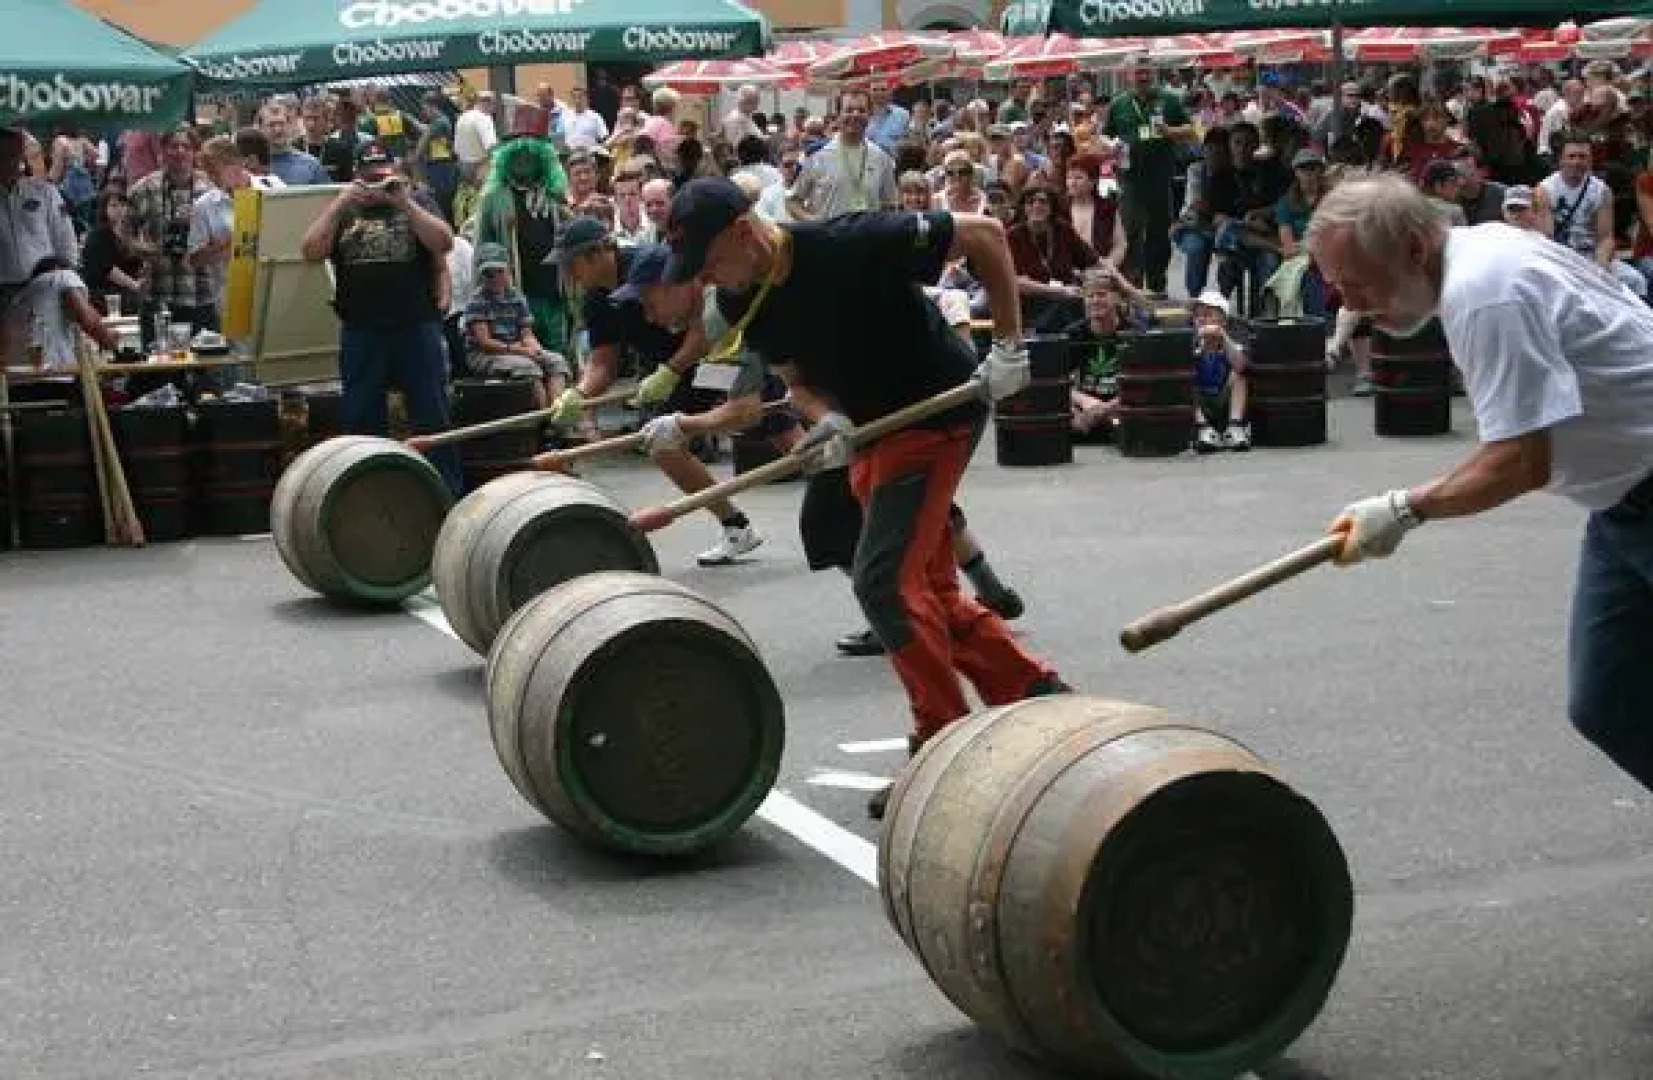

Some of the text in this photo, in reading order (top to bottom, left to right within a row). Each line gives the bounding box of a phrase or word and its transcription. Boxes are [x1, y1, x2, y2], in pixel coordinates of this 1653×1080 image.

[332, 37, 445, 66] Chobovar
[481, 28, 591, 55] Chobovar
[623, 25, 740, 51] Chobovar
